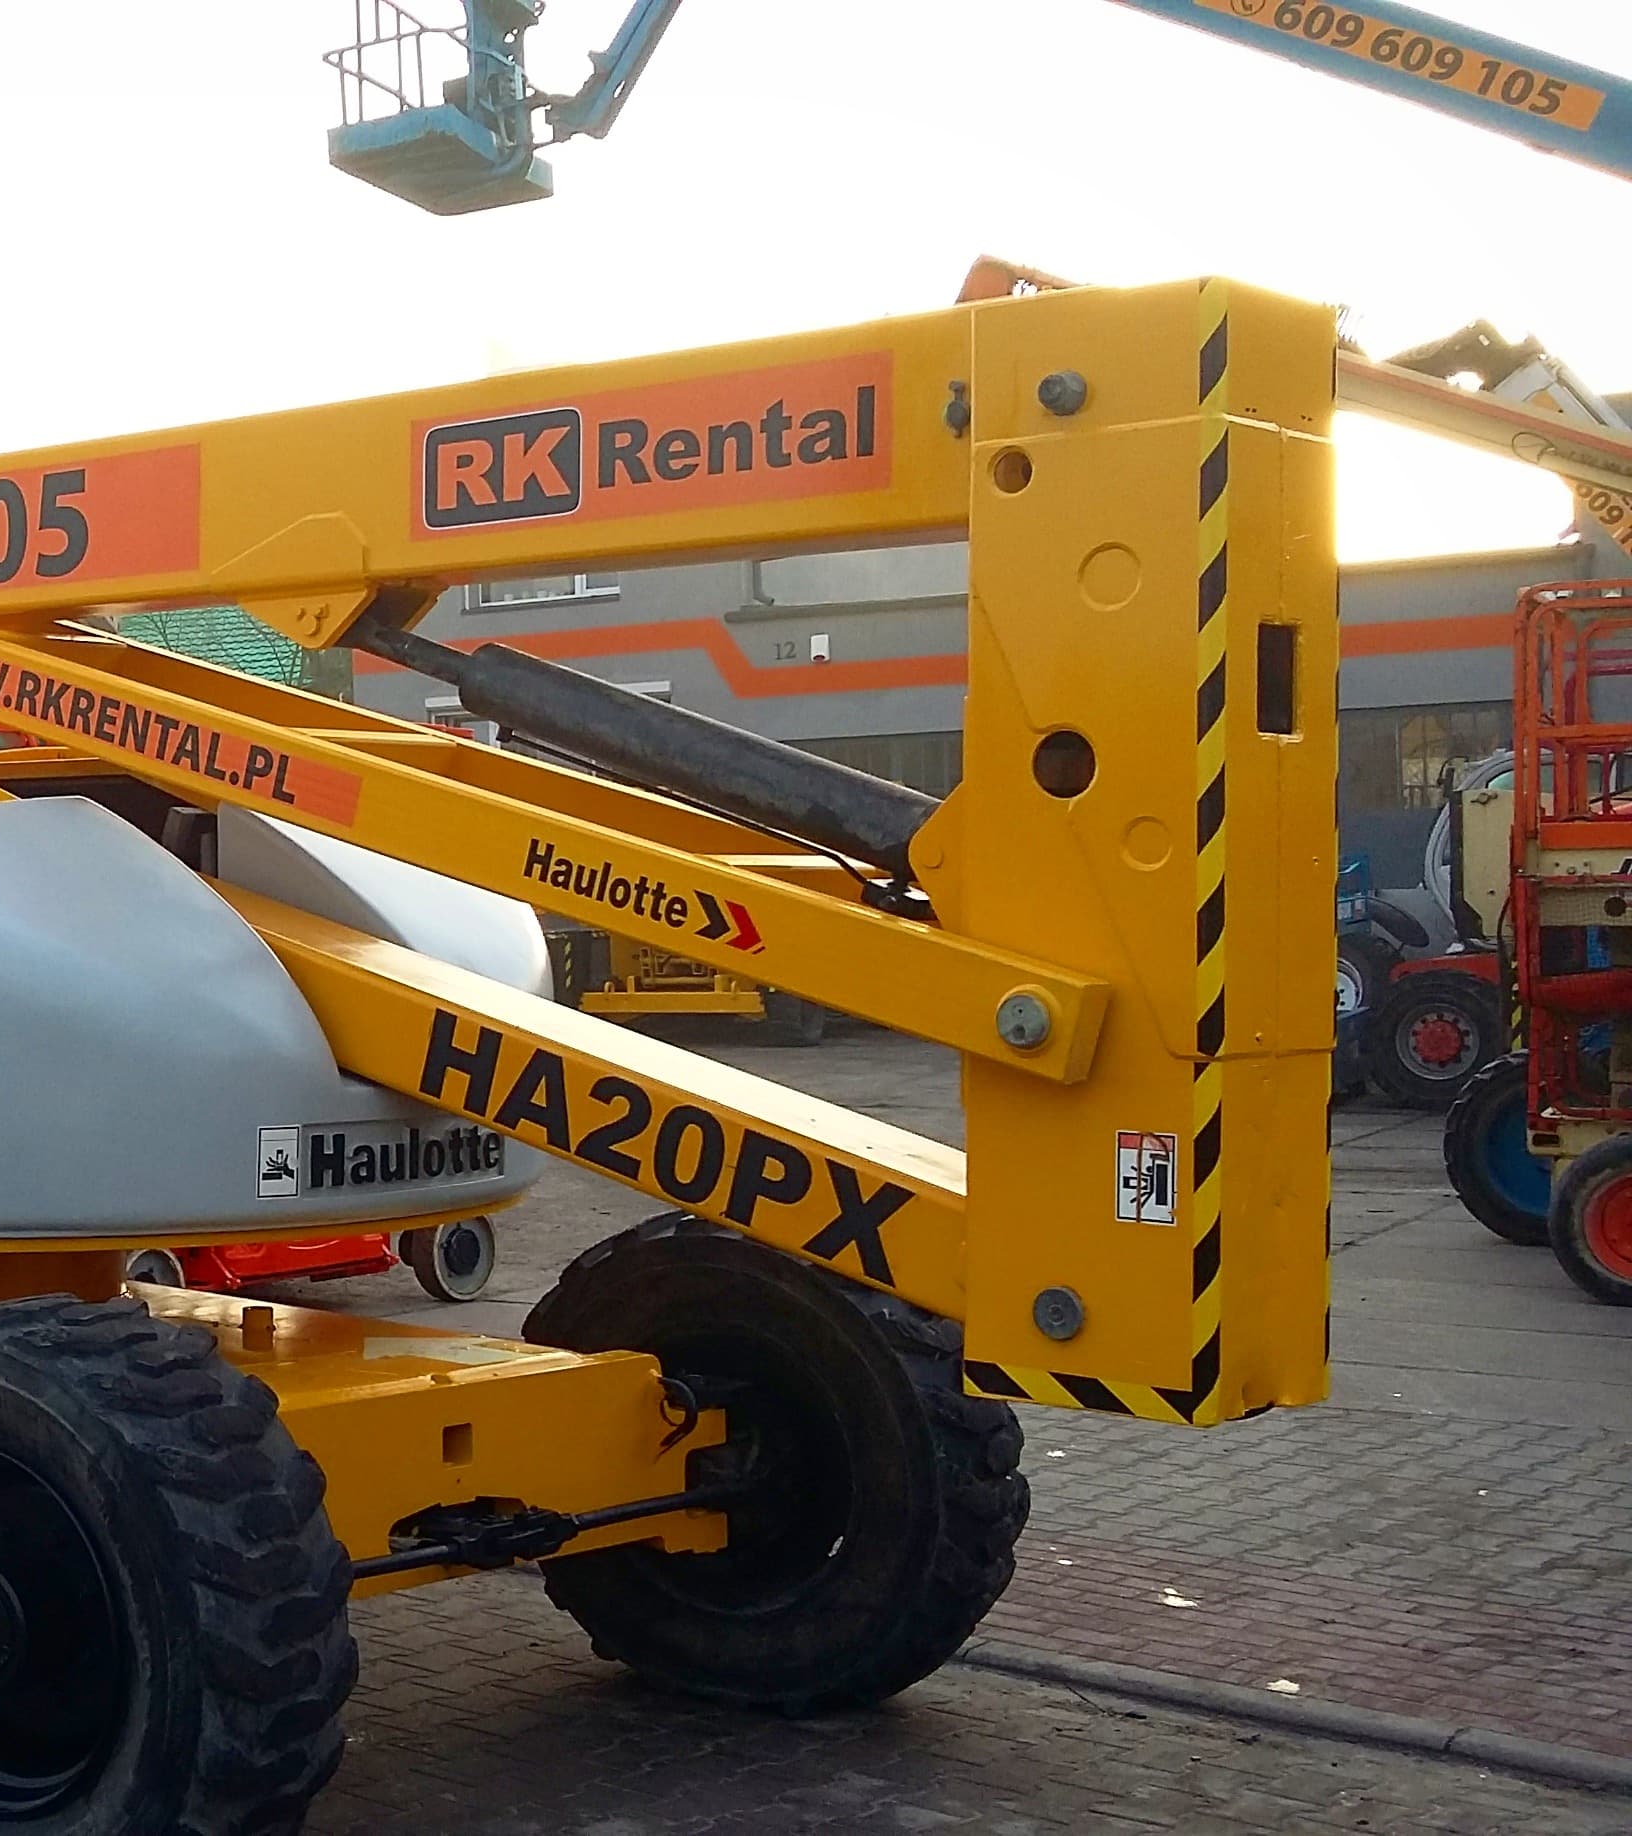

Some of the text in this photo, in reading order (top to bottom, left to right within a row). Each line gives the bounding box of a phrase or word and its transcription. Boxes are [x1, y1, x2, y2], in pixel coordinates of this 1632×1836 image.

[1273, 0, 1568, 117] 609 609 105
[435, 385, 876, 511] RK Rental
[774, 641, 797, 660] 12
[523, 837, 689, 929] Haulotte
[310, 1125, 504, 1190] Haulotte
[418, 1007, 917, 1289] HA20PX
